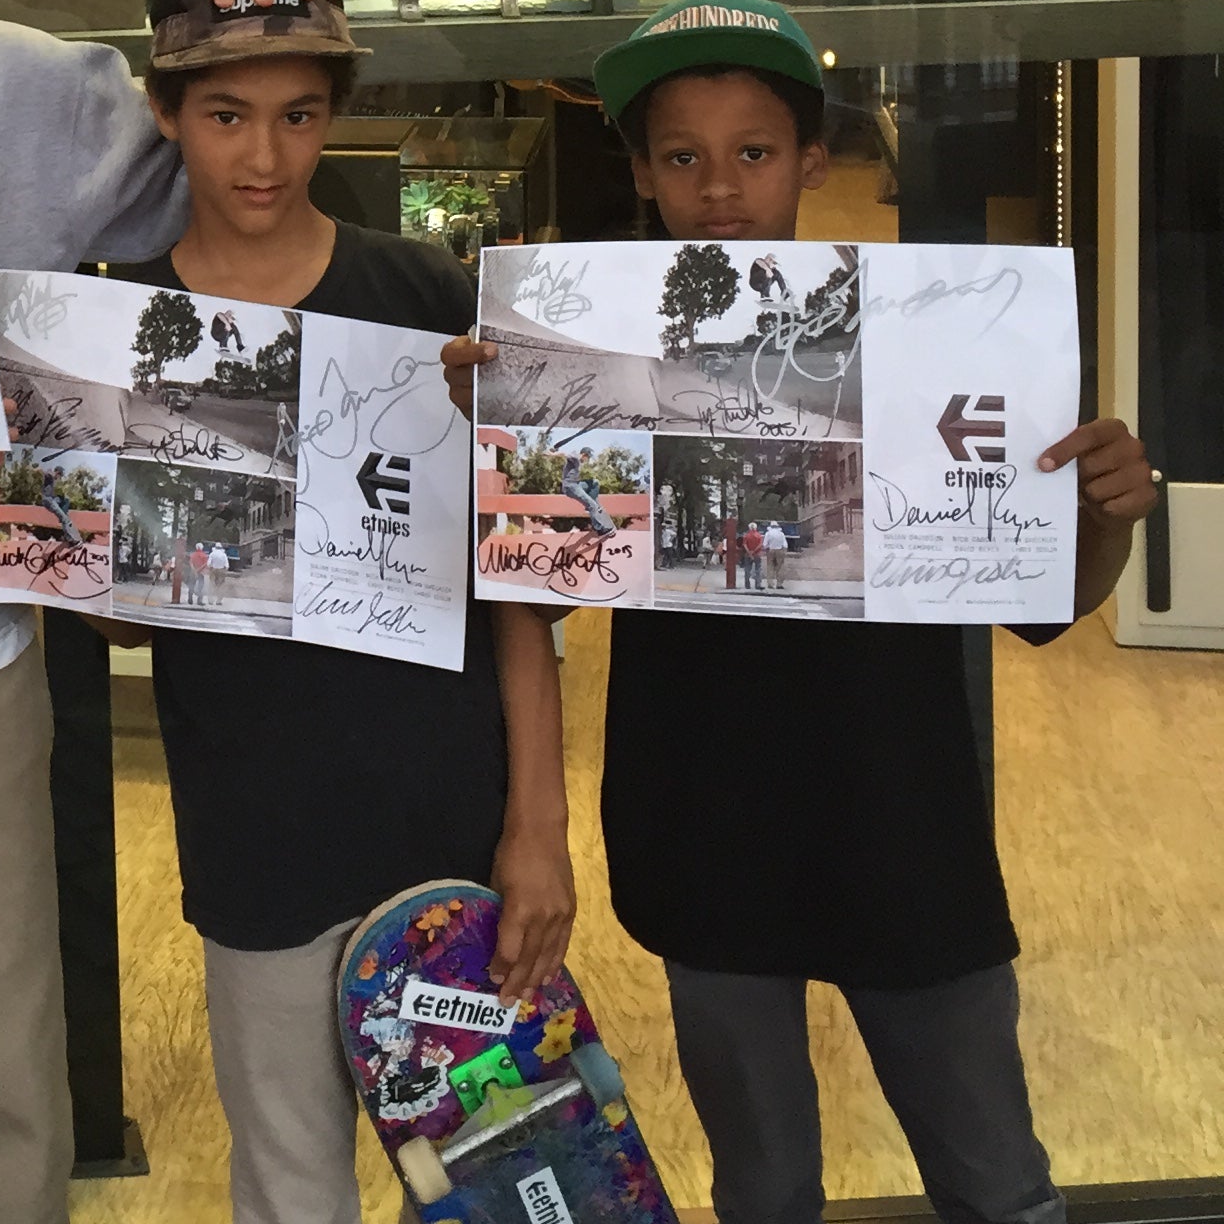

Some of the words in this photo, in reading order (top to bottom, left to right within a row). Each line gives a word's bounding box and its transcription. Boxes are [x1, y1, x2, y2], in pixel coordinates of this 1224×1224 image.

[945, 467, 1007, 490] etnies
[361, 514, 411, 538] etnies
[434, 996, 509, 1029] etnies
